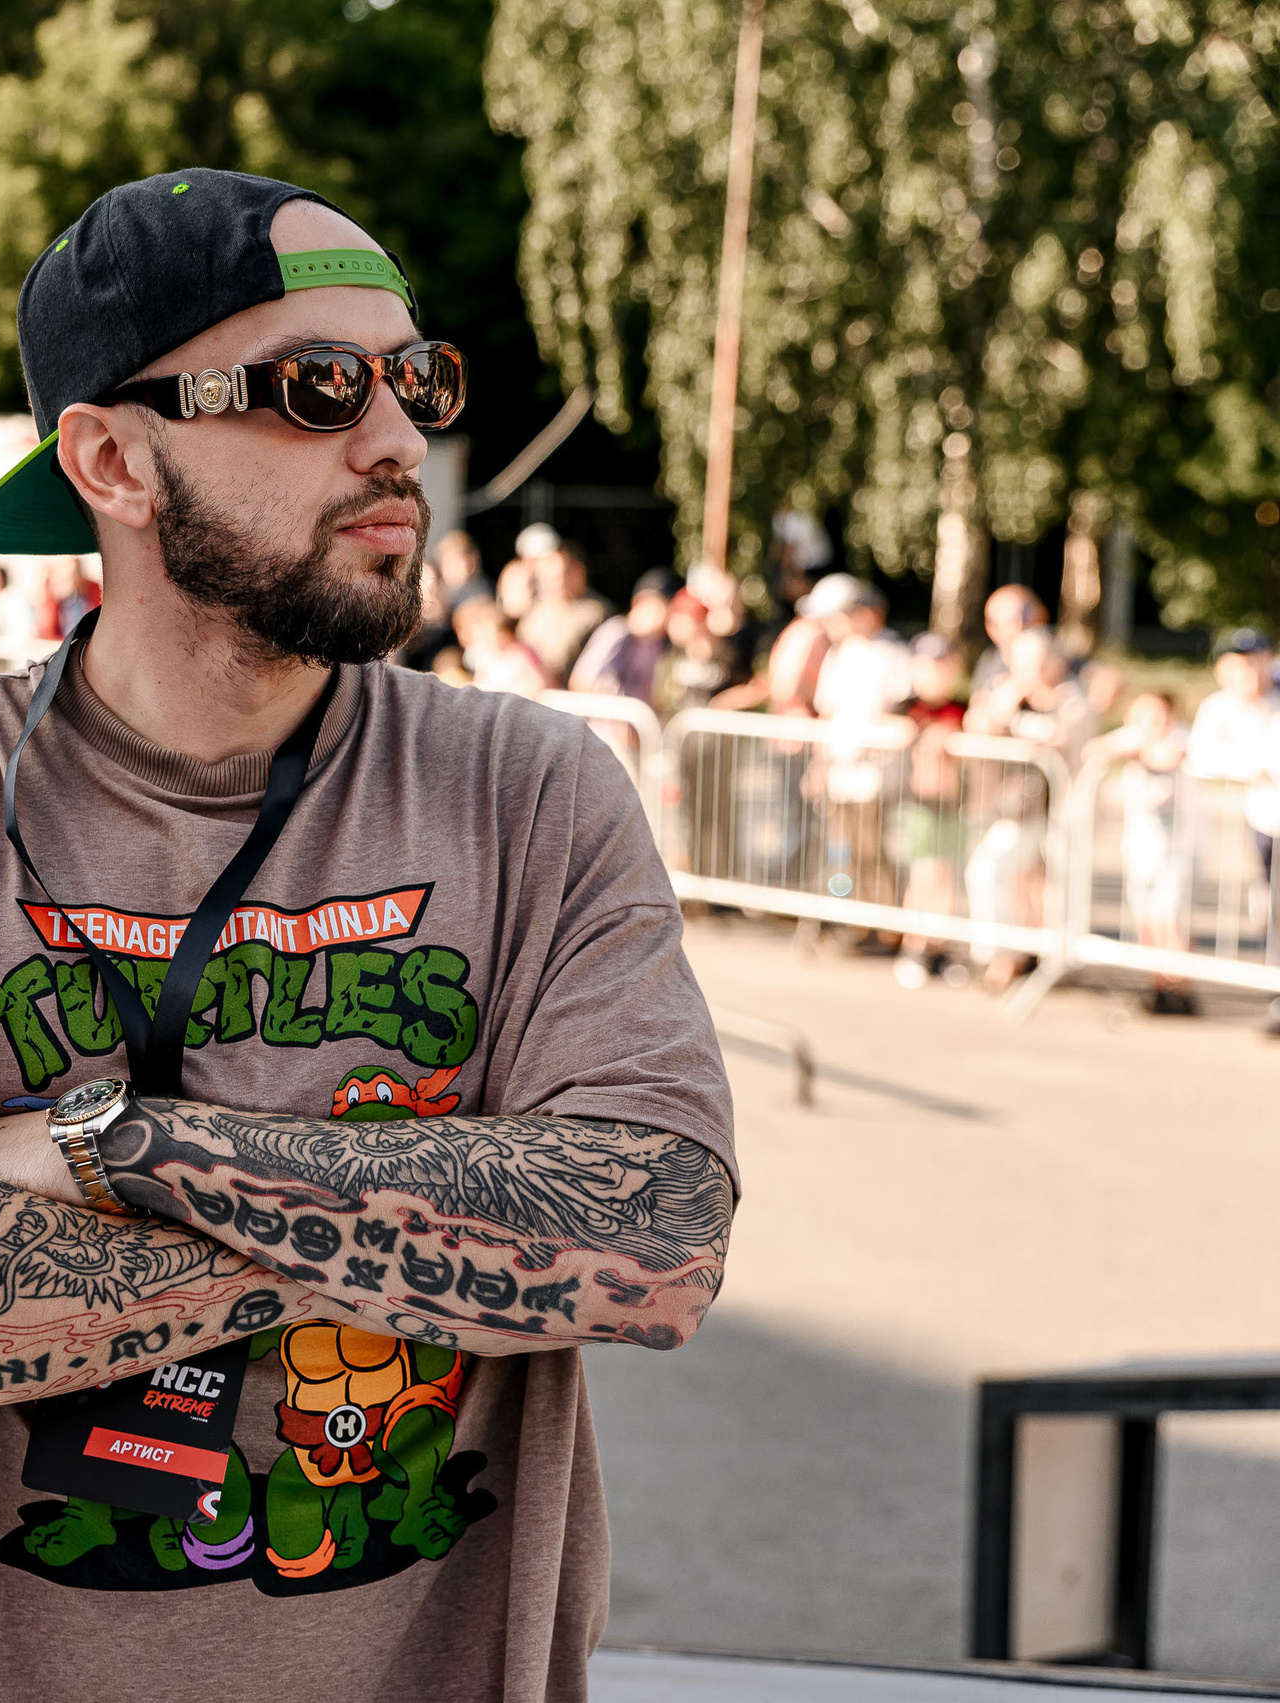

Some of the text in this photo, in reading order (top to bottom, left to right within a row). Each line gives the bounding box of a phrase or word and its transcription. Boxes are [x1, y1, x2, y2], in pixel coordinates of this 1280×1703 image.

[214, 911, 298, 953] UTANT
[307, 898, 411, 946] NINJA
[150, 1362, 226, 1399] RCC
[108, 1439, 175, 1464] АРТИСТ
